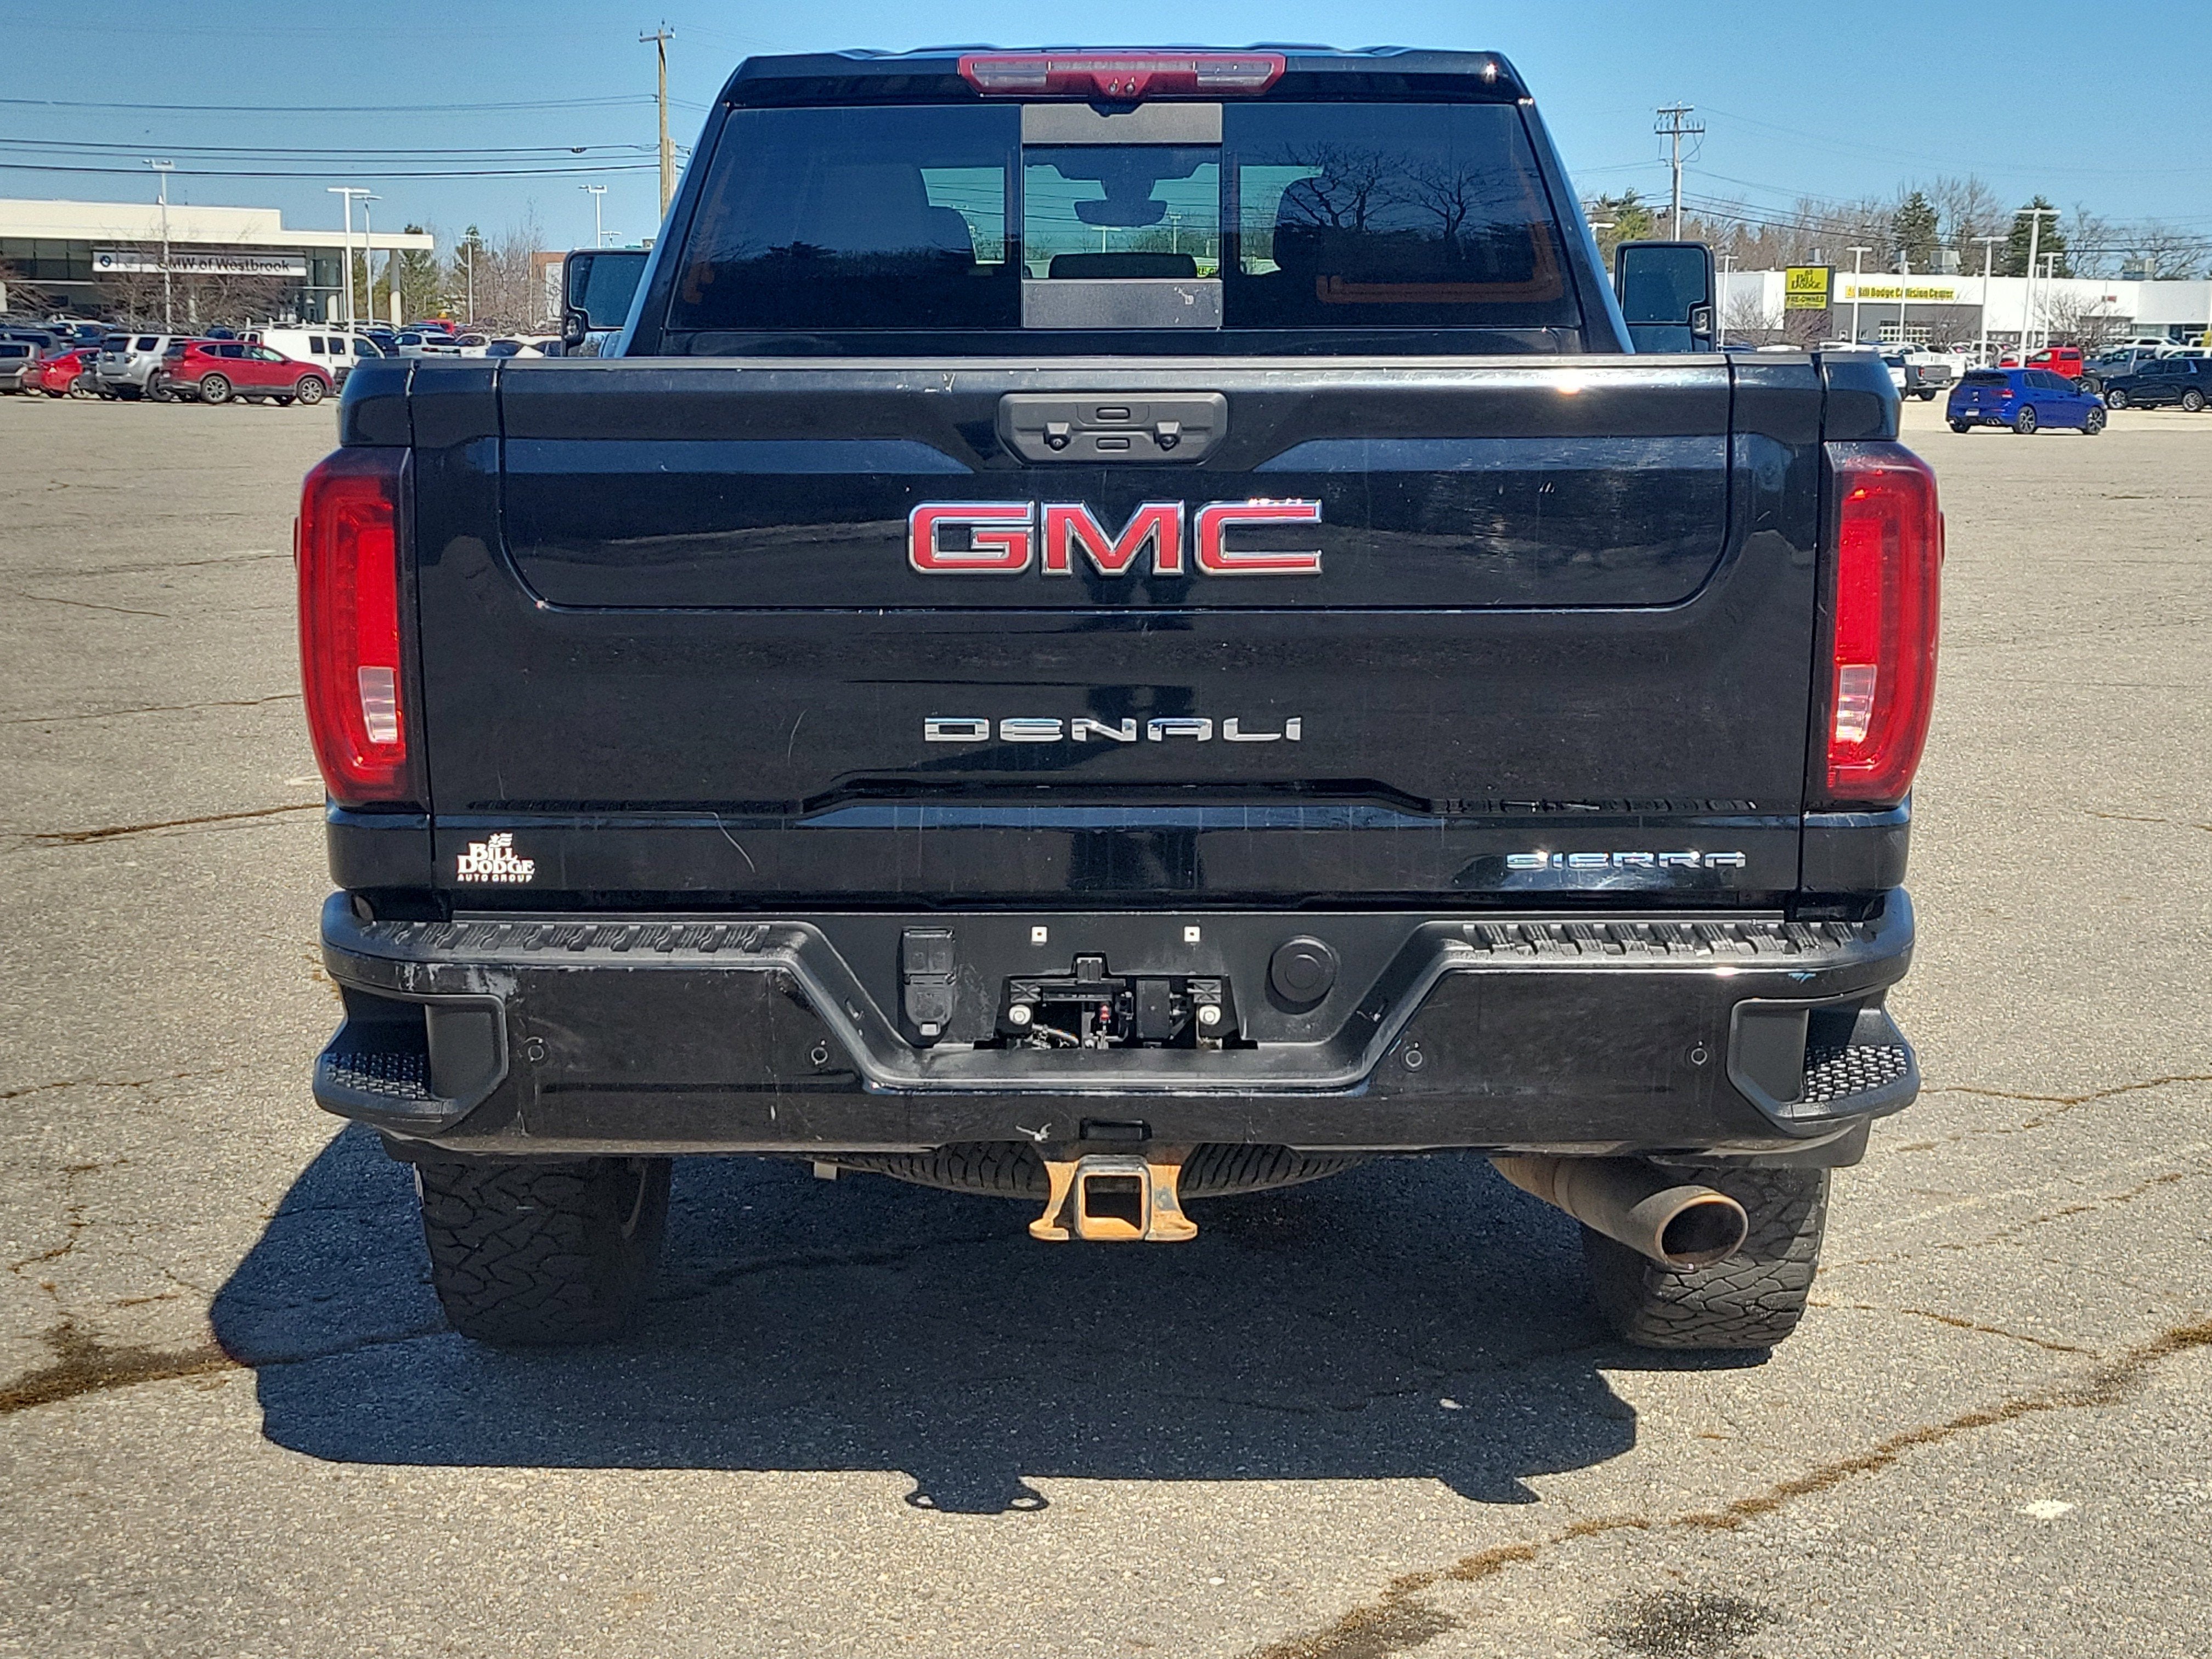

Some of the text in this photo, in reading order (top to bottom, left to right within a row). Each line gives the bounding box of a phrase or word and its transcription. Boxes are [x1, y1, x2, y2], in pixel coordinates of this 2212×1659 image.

[199, 257, 213, 270] of
[215, 258, 289, 272] Westbrook
[907, 499, 1323, 577] GMC
[924, 716, 1302, 742] DENALI
[1506, 850, 1746, 870] SIERRA
[457, 873, 533, 883] AUTO GROUP
